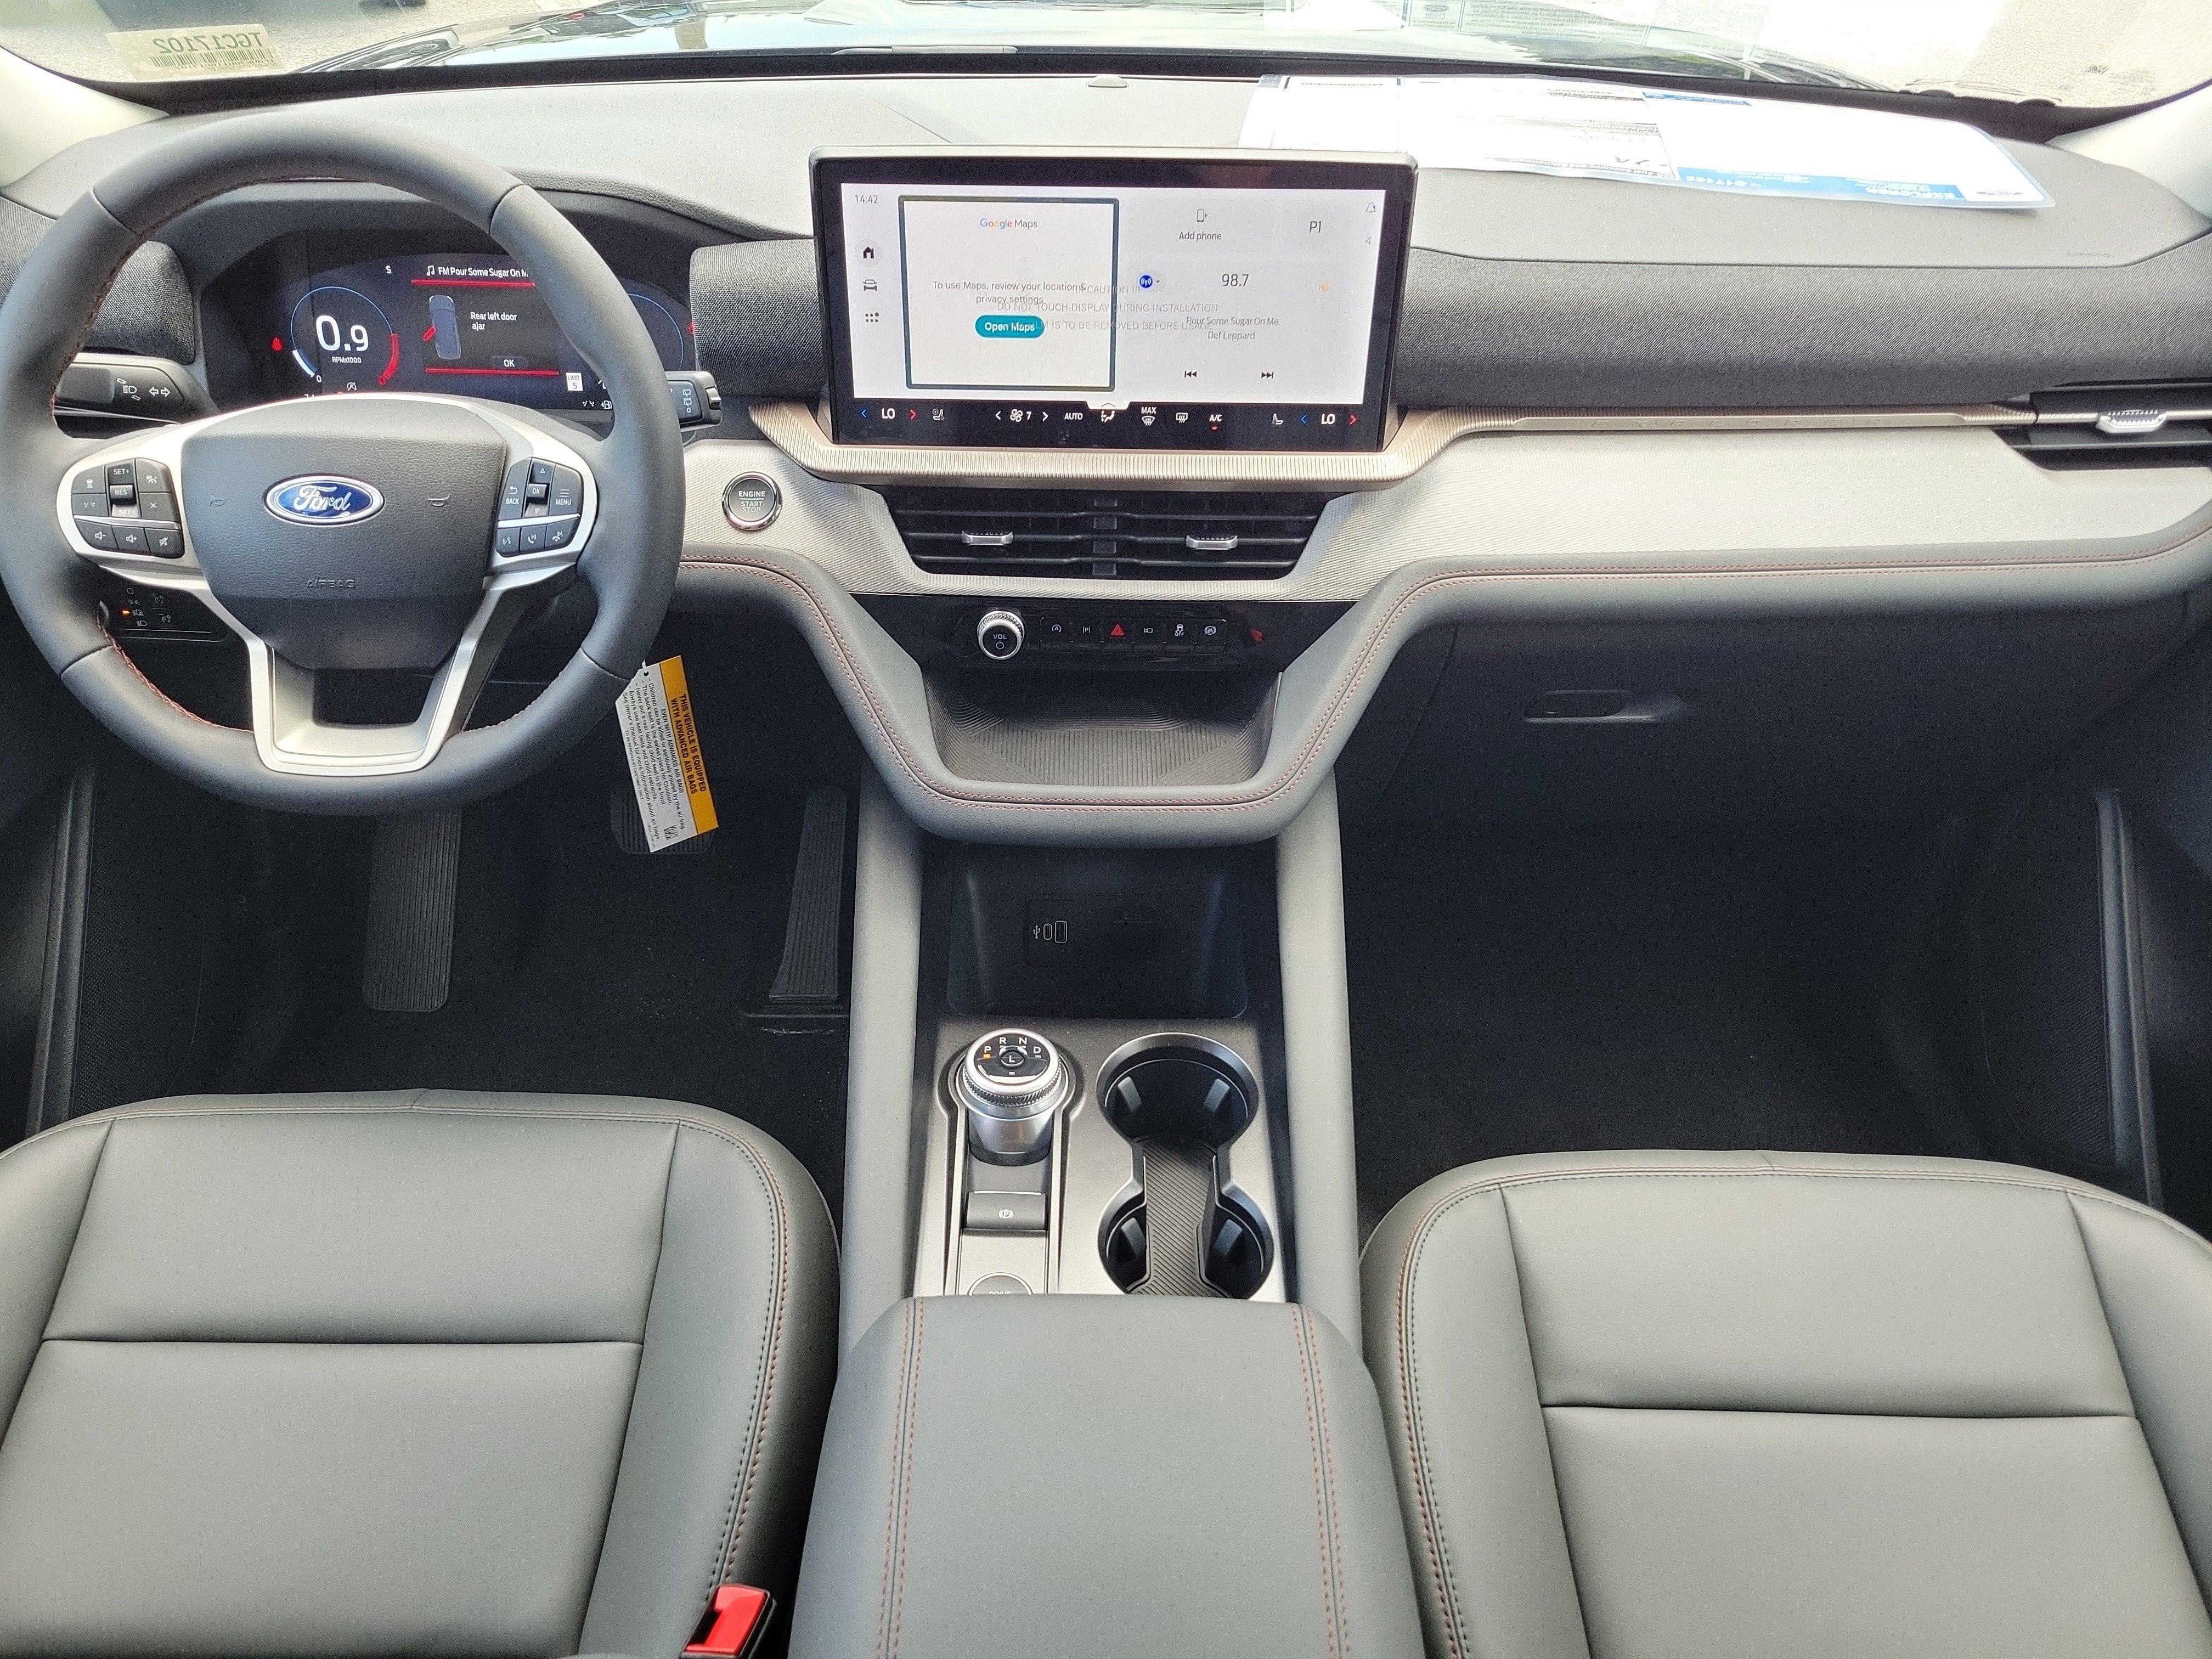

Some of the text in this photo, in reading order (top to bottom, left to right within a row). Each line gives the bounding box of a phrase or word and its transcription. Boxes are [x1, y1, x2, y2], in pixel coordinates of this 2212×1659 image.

[855, 195, 878, 204] 14:42
[980, 218, 1037, 229] Google Maps
[1310, 221, 1322, 233] P1
[1179, 232, 1222, 241] Add phone
[386, 266, 392, 274] S
[438, 267, 449, 275] FM
[450, 267, 467, 276] Pour
[468, 268, 488, 276] Some
[489, 268, 509, 278] Sugar
[510, 268, 521, 277] On
[1221, 273, 1249, 287] 98.7
[933, 281, 943, 289] To
[963, 281, 988, 291] Maps,
[991, 282, 1019, 290] review
[1022, 283, 1041, 292] your
[1043, 282, 1077, 291] location
[1080, 283, 1086, 291] &
[1087, 285, 1128, 294] CAUTION
[976, 294, 1043, 305] privacy settings
[997, 302, 1218, 312] DO NOT TOUCH DISPLAY DURING INSTALLATION
[471, 312, 517, 321] Rear left door
[1186, 317, 1279, 327] Pour Some Sugar On Me
[472, 322, 486, 331] ajar
[984, 321, 1035, 334] Open Maps
[1064, 321, 1075, 329] TO
[1079, 321, 1091, 329] BE
[1094, 321, 1139, 329] REMOVED
[1142, 321, 1178, 330] BEFORE
[1182, 321, 1213, 330] USAGE
[315, 315, 369, 352] 0.9
[1207, 331, 1255, 341] Def Leppard
[504, 359, 515, 368] OK
[882, 409, 895, 420] LO
[1026, 411, 1031, 420] 7
[1321, 414, 1335, 425] LO
[113, 467, 129, 476] SET+
[293, 484, 353, 512] Ford
[305, 578, 356, 589] AIRBAG
[648, 682, 658, 706] Children
[627, 690, 637, 710] Always
[635, 687, 643, 704] Never
[644, 731, 653, 749] facing
[657, 725, 665, 741] killed
[653, 739, 662, 756] safest
[670, 697, 697, 795] WITH ADVANCED AIR BAGS
[679, 693, 707, 792] THIS VEHICLE IS EQUIPPED
[624, 703, 634, 726] owner's
[629, 726, 639, 747] manual
[640, 770, 651, 802] information
[660, 708, 668, 723] EVEN
[667, 738, 678, 767] ADVANCED
[676, 778, 684, 793] BAGS
[657, 756, 665, 771] place
[662, 748, 673, 774] seriously
[668, 773, 677, 793] injured
[672, 793, 679, 801] by
